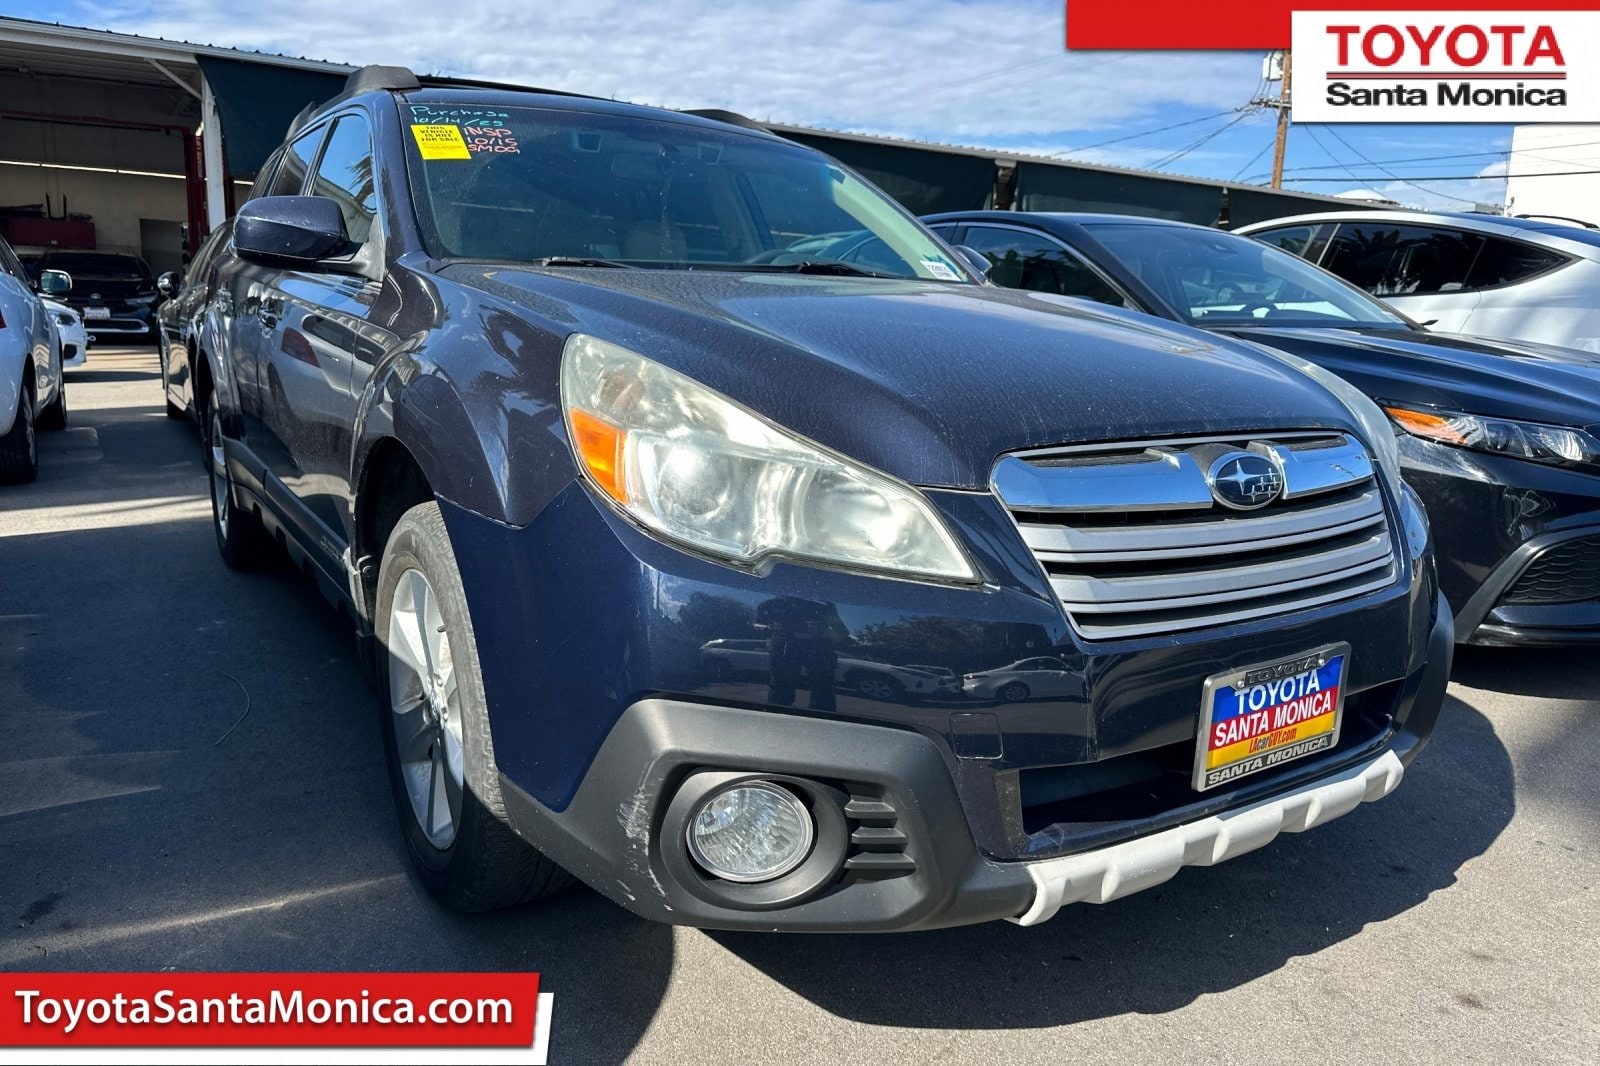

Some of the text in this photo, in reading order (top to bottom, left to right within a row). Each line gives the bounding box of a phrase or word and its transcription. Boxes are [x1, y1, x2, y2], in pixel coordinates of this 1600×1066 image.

[463, 126, 512, 137] INSP
[468, 144, 521, 154] SMOG
[1247, 658, 1318, 683] TOYOTA
[1235, 669, 1320, 715] TOYOTA
[1214, 690, 1331, 747] SANTA MONICA
[1208, 736, 1329, 785] SANTA MONICA
